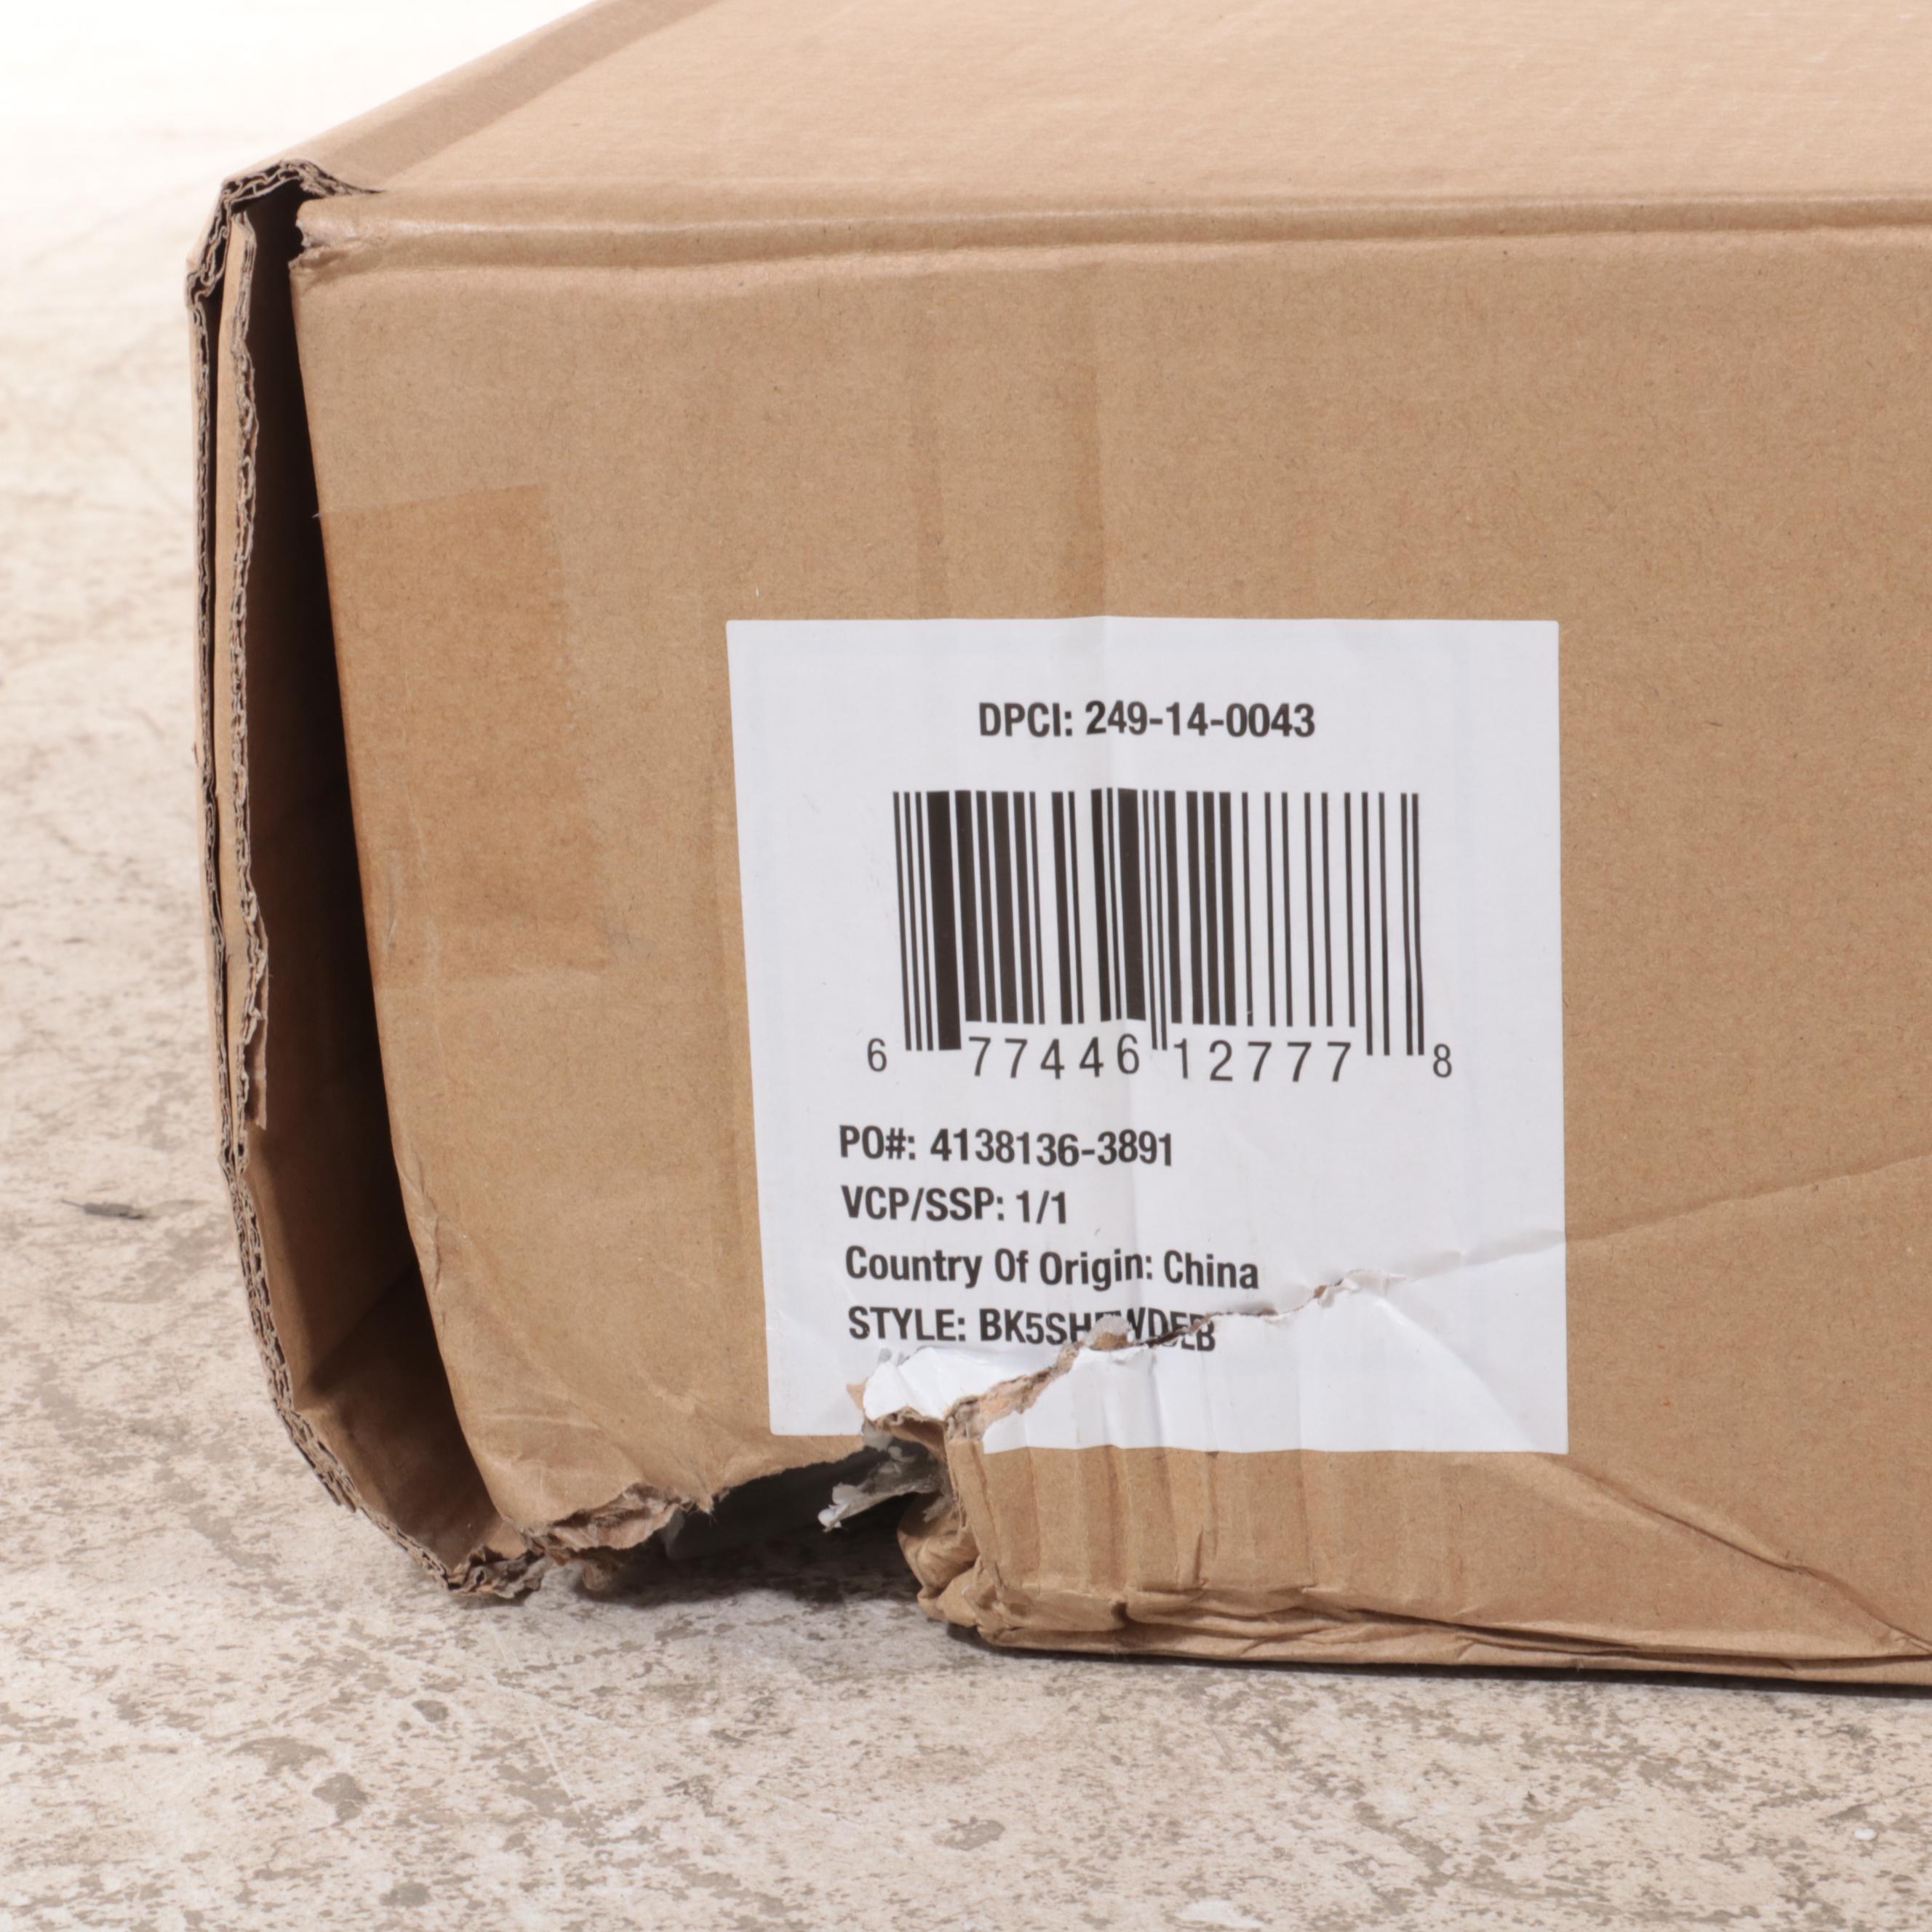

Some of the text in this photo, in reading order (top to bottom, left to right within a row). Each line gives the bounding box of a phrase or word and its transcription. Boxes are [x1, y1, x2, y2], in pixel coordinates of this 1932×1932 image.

[979, 700, 1315, 738] DPCI: 249-14-0043
[839, 1125, 1171, 1167] PO#: 4138136-3891
[841, 1185, 1066, 1224] VCP/SSP: 1/1
[845, 1245, 1258, 1292] Country Of Origin: China
[848, 1306, 1216, 1352] STYLE: BK5SHWDEB
